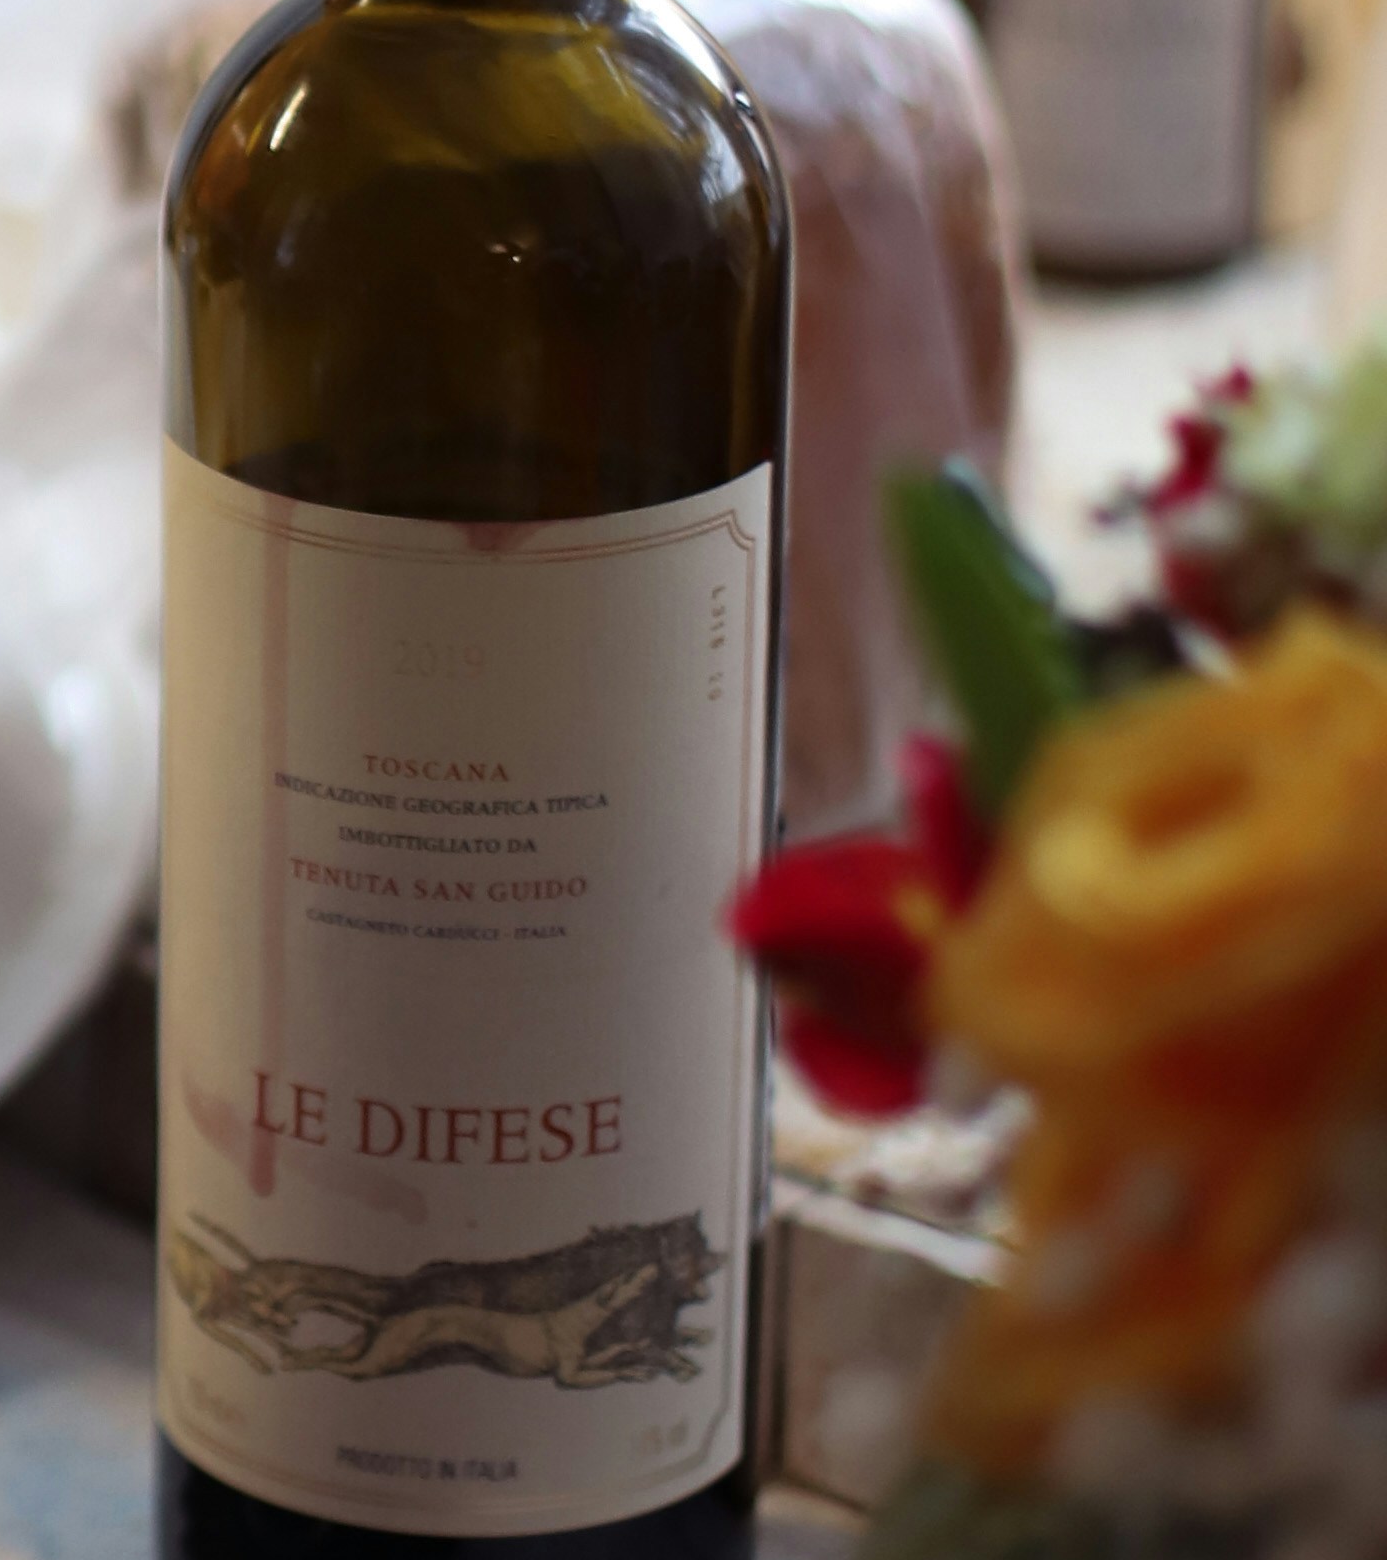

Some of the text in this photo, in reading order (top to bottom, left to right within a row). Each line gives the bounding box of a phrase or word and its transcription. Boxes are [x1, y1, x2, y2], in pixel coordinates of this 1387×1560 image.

[363, 753, 510, 782] TOSCANA
[274, 771, 610, 817] INDICAZIONE GEOGRAFICA TIPICA
[338, 825, 538, 854] IMBOTTIGLIATO DA
[289, 857, 588, 903] TENUTA SAN GUIDO
[251, 1070, 625, 1166] LE DIFESE
